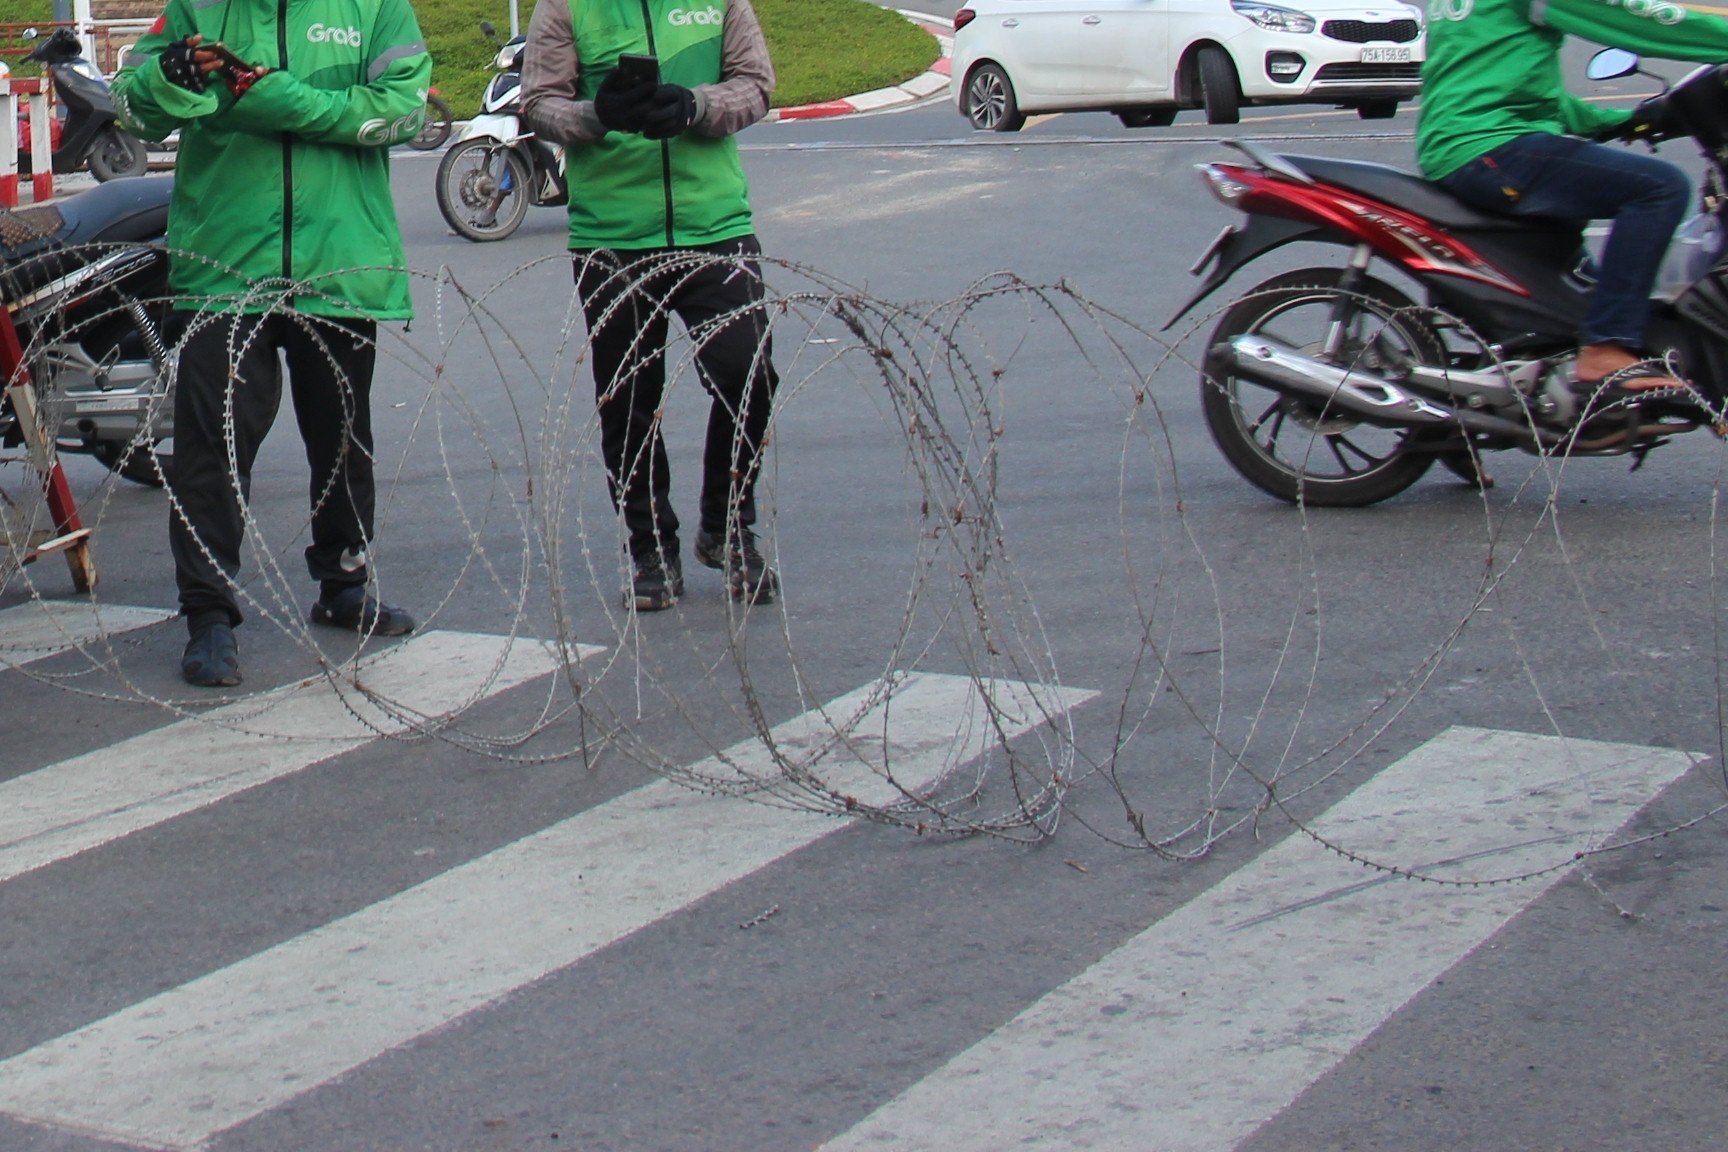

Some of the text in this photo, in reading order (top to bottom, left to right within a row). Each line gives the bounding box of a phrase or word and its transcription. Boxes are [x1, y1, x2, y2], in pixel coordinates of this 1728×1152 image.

[668, 5, 724, 26] Grab
[306, 22, 362, 48] Grab
[356, 98, 426, 146] Gra
